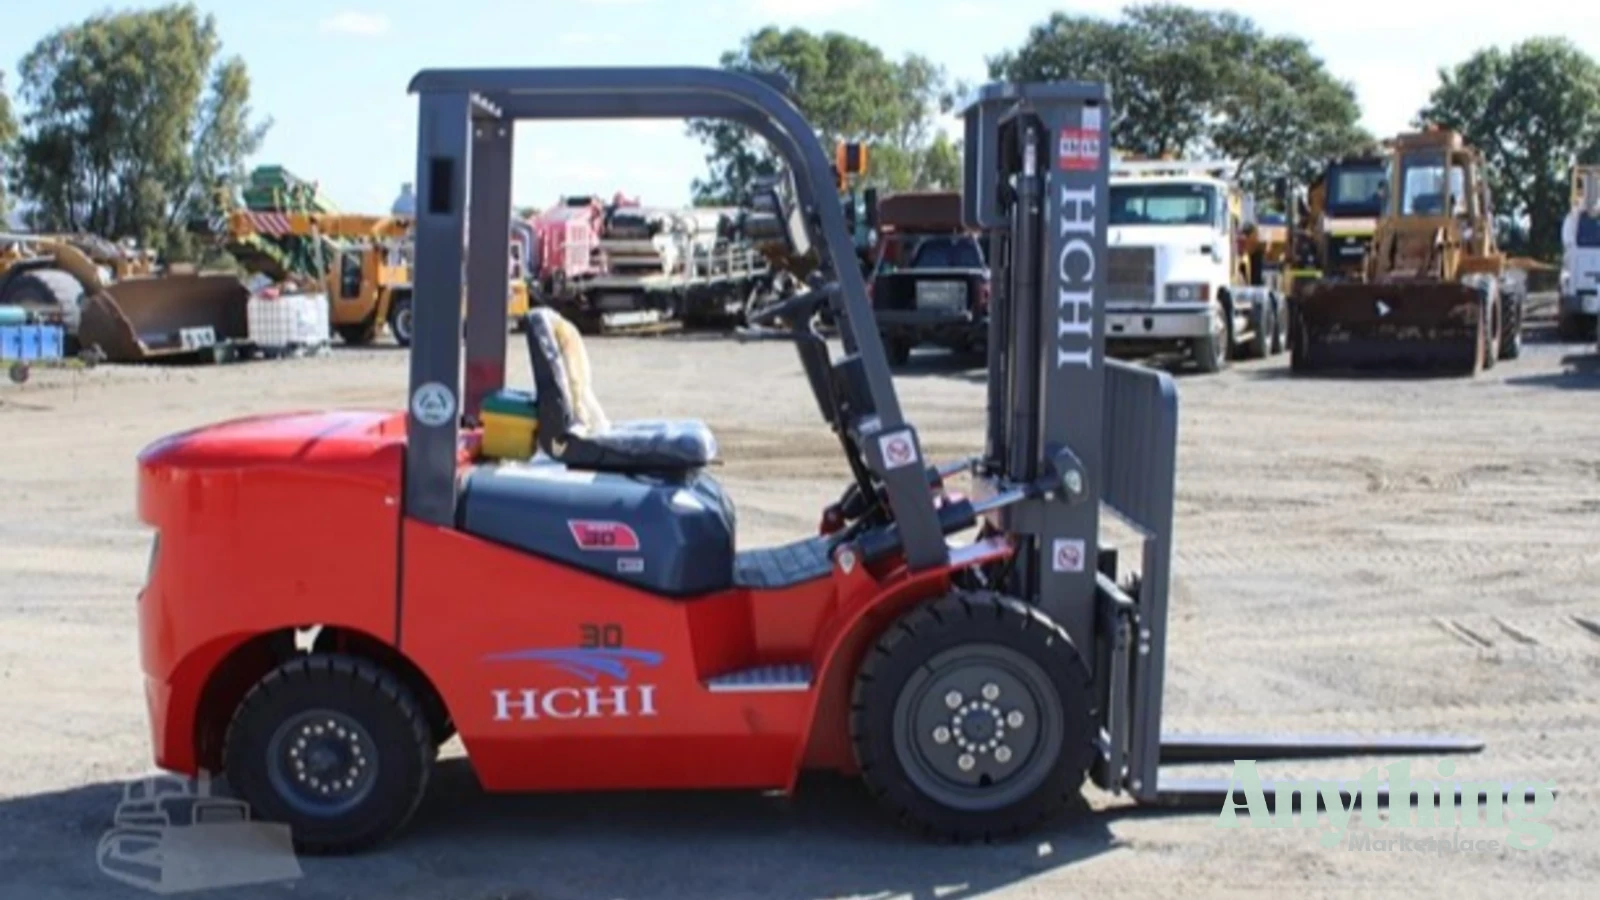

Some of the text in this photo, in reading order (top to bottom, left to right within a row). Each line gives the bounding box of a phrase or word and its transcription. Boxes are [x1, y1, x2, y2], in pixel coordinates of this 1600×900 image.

[1058, 184, 1096, 368] HCHI
[579, 623, 622, 649] 30
[492, 684, 657, 721] HCHI
